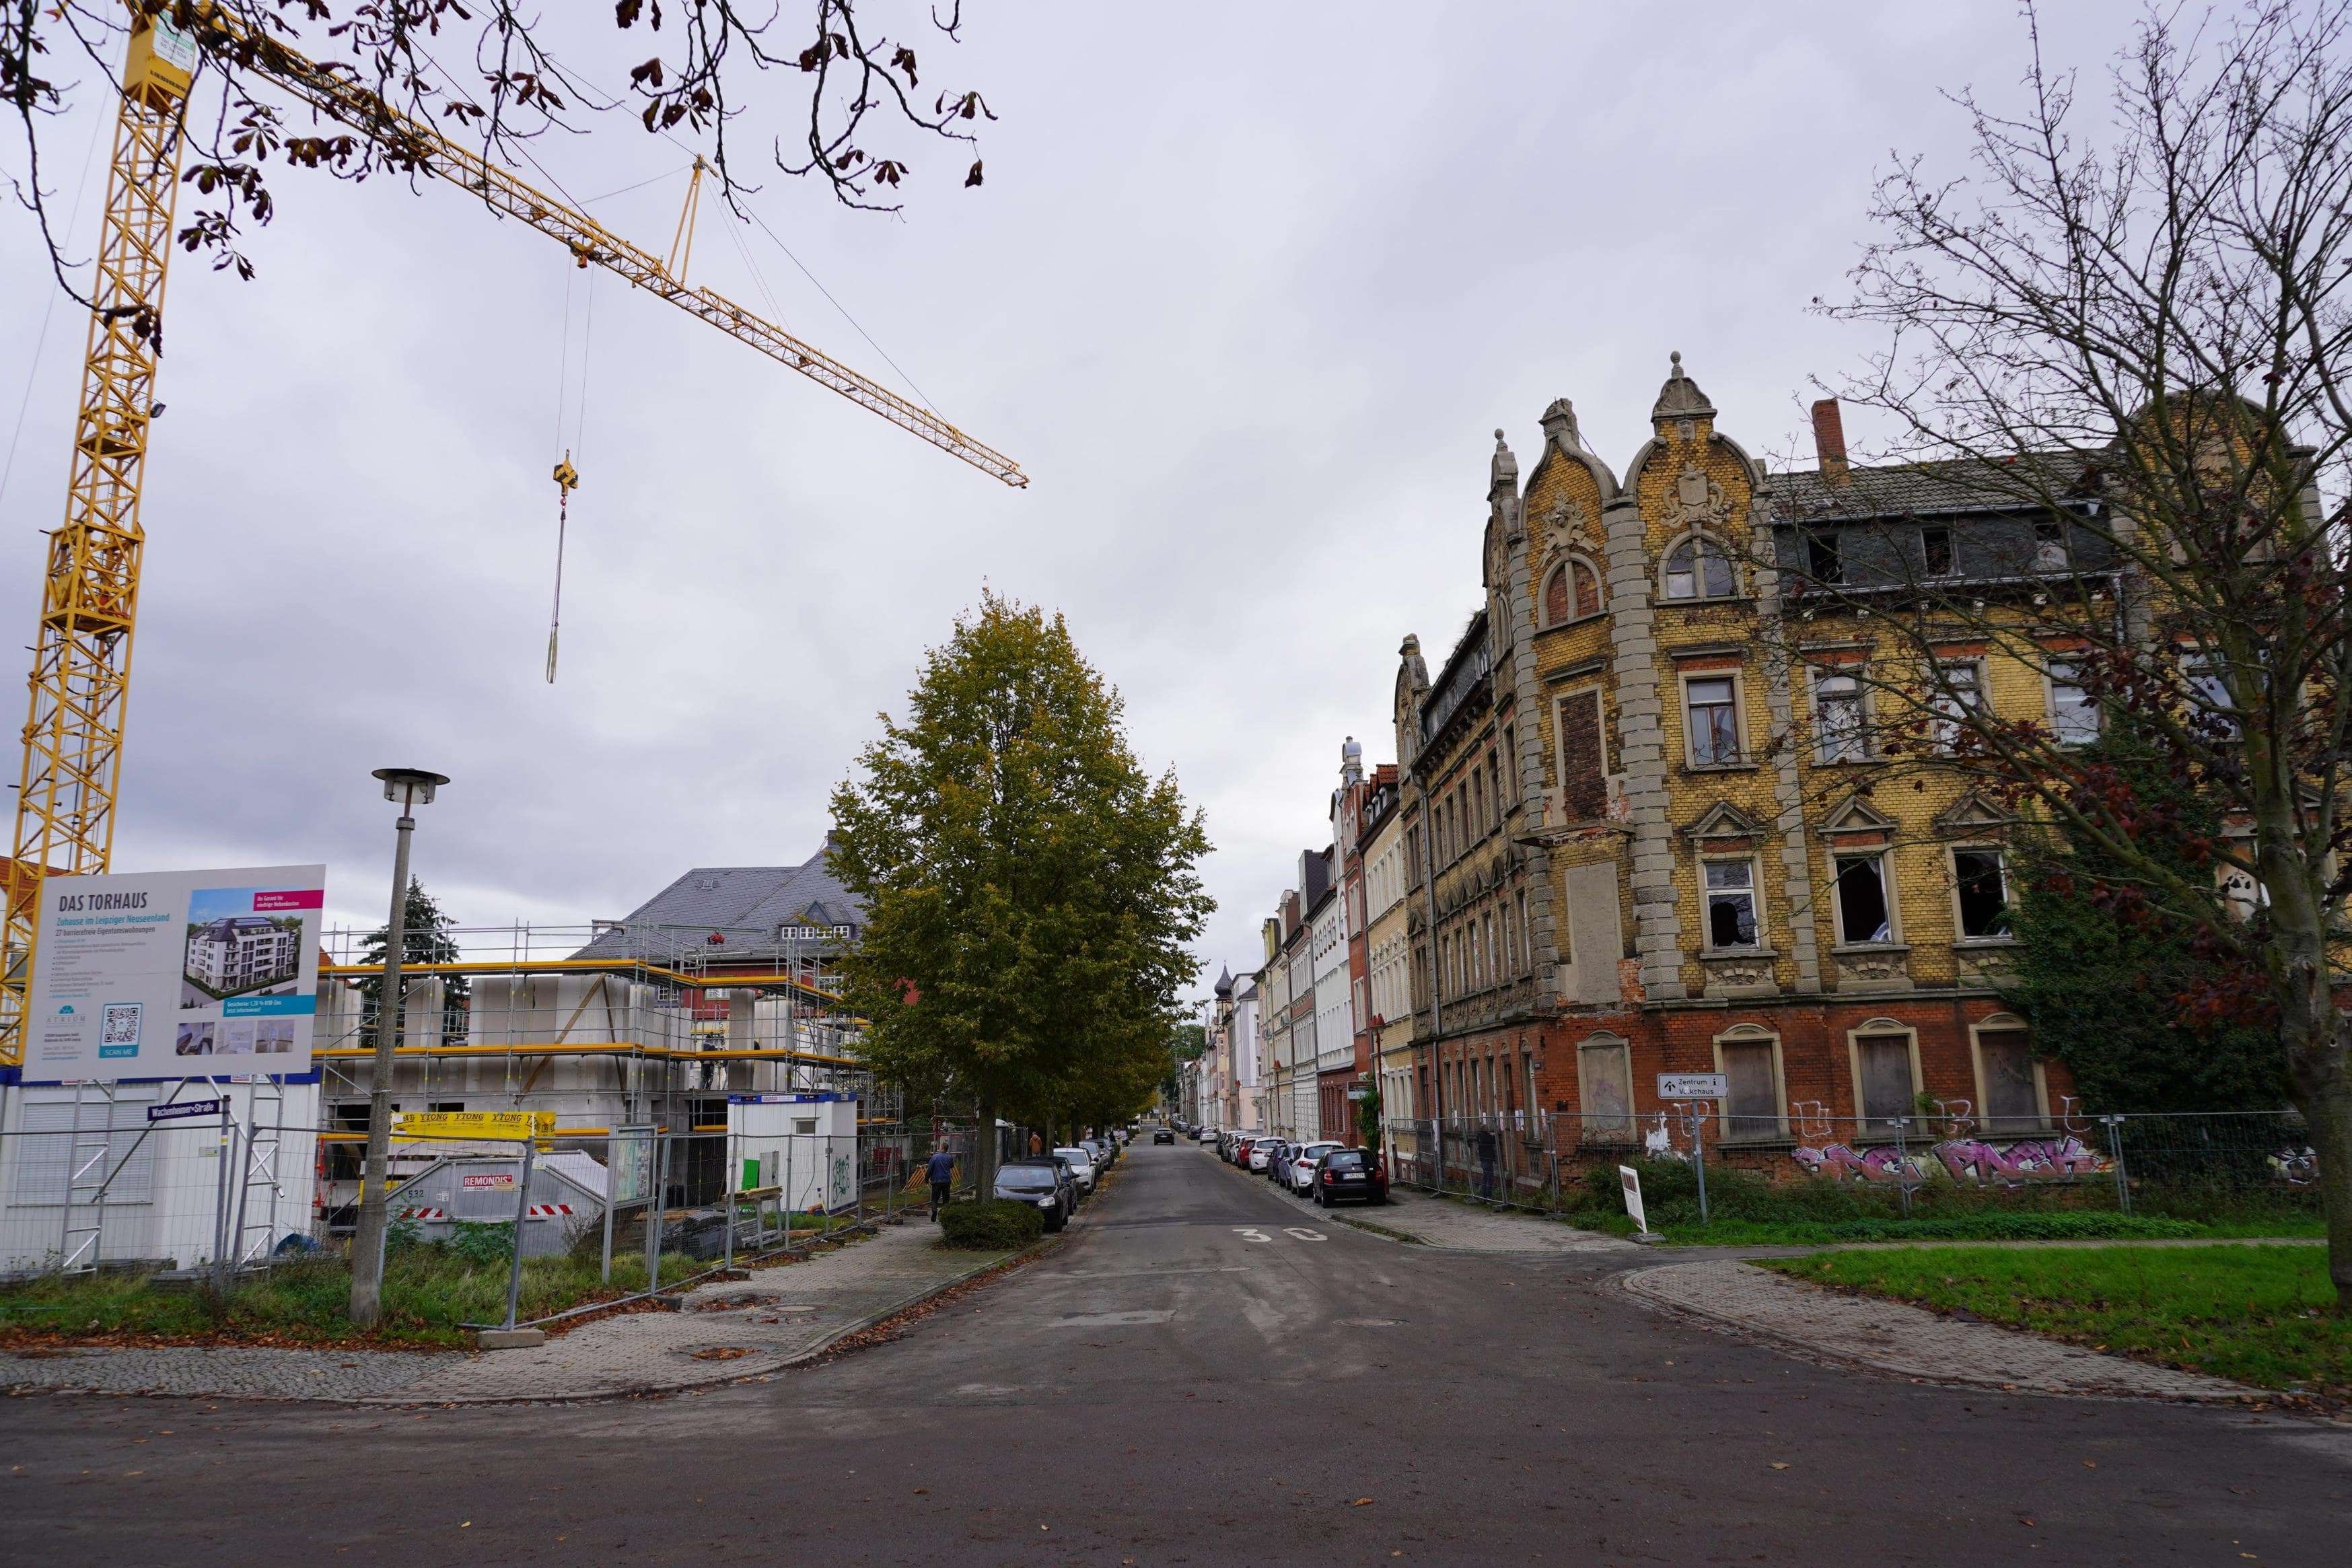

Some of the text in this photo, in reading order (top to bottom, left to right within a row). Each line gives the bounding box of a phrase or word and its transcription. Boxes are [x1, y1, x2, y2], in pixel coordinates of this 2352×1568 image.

[59, 892, 148, 912] DAS TORHAUS
[57, 913, 170, 926] Zuhause im Leipziger Neuseenland
[63, 928, 96, 936] barrierefreie
[97, 926, 155, 935] Eigentumswohnungen
[152, 1102, 214, 1117] Wachenheimer-Straße
[420, 1113, 448, 1121] YTONG
[492, 1113, 522, 1122] YTONG
[464, 1175, 508, 1186] REMONDIS
[408, 1190, 425, 1199] 532
[1232, 1227, 1328, 1242] 30
